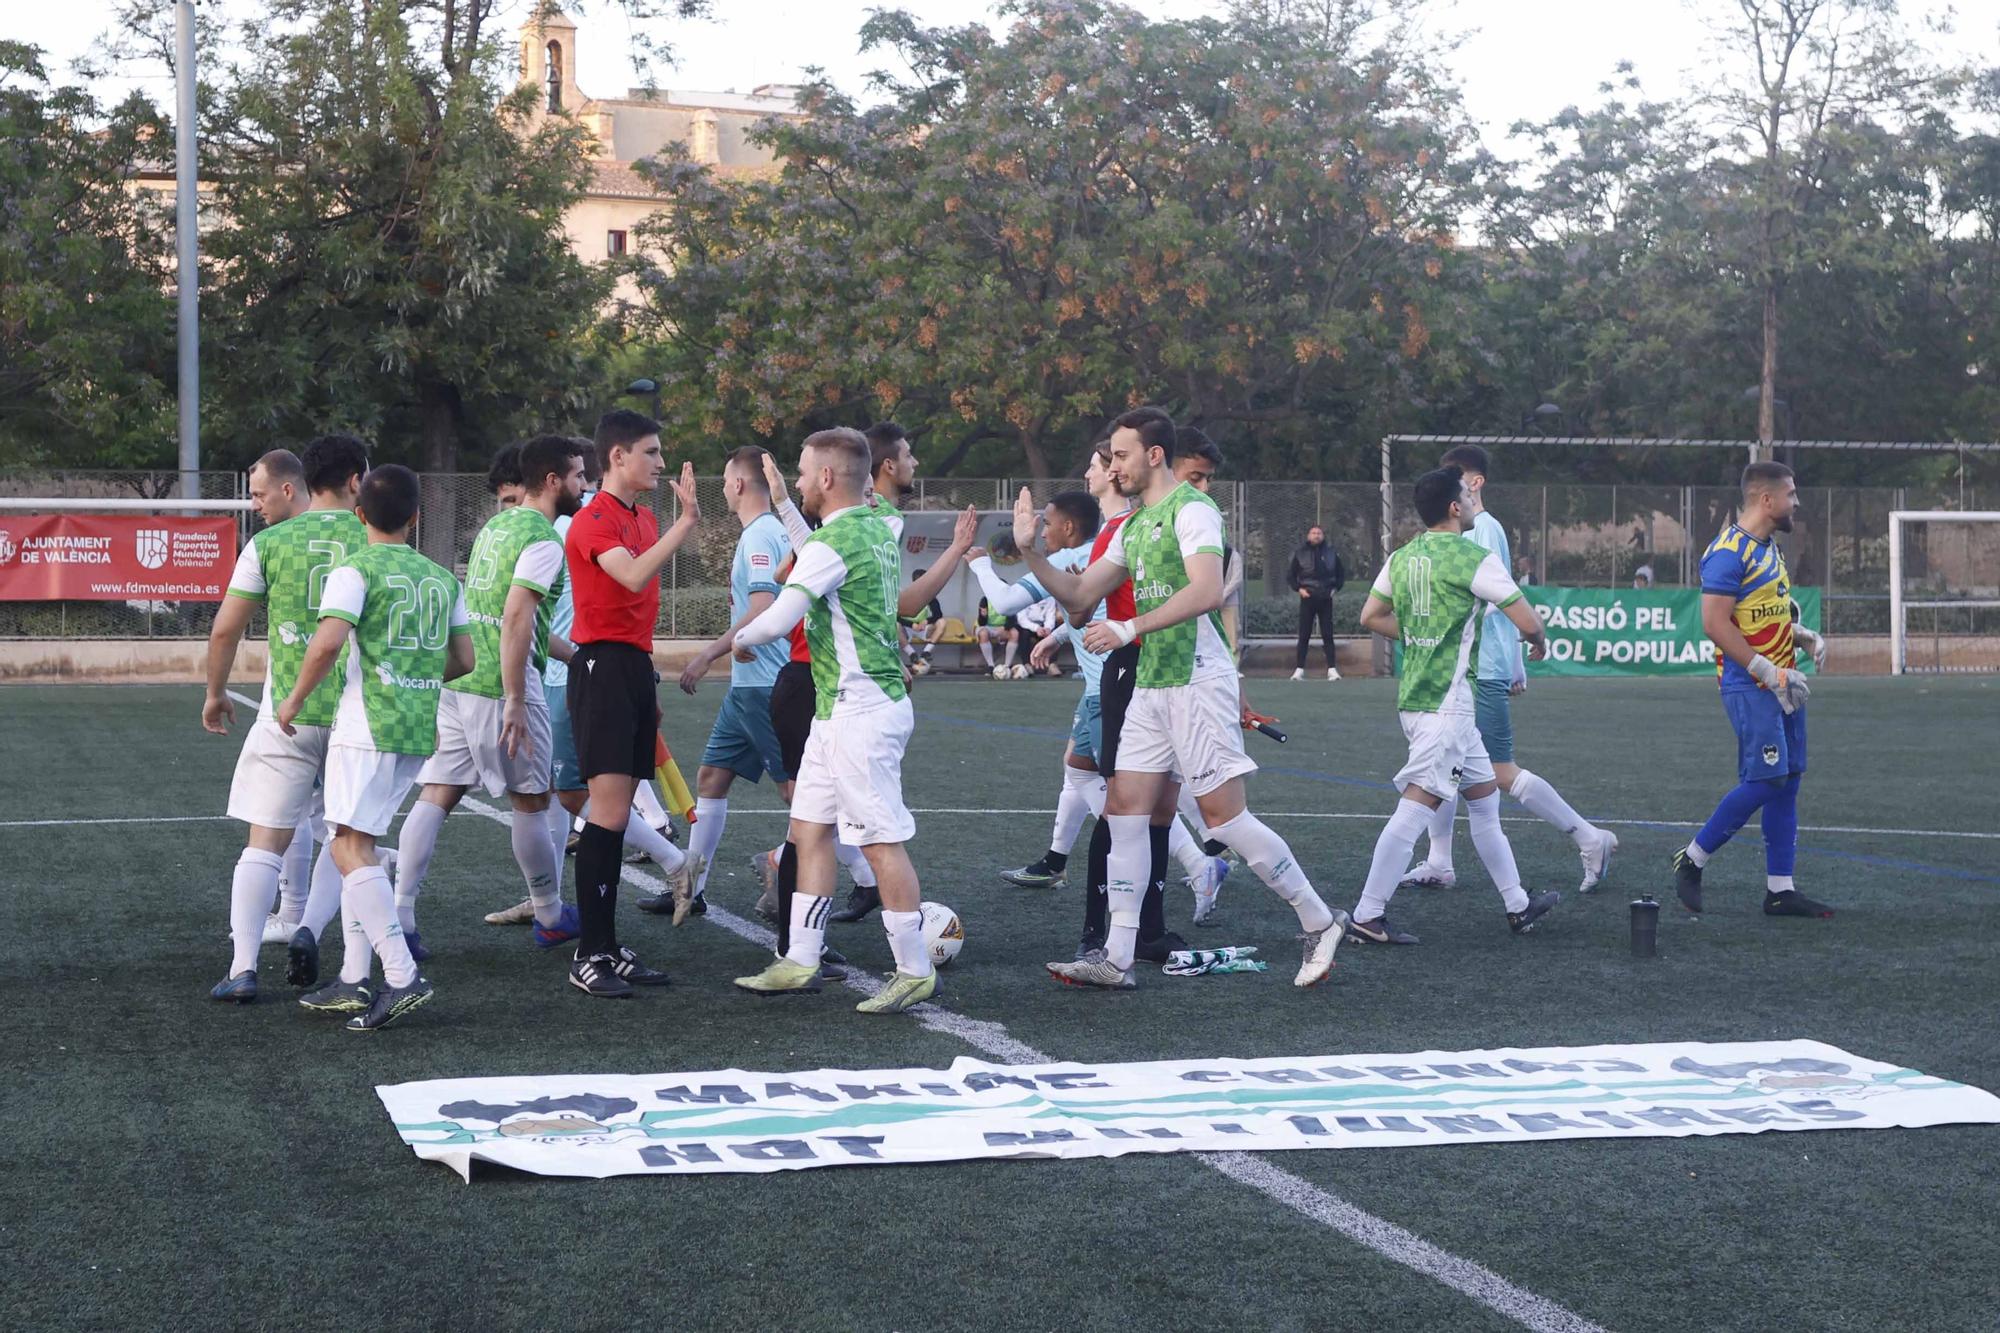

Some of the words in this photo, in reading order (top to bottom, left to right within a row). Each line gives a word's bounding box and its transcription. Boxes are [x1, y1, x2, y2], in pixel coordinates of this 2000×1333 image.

[22, 536, 112, 549] AJUNTAMENT
[173, 532, 218, 541] Fundació
[173, 541, 219, 551] Esportiva
[21, 552, 39, 564] DE
[45, 548, 112, 564] VALÈNCIA
[172, 558, 214, 567] València
[173, 550, 220, 560] Municipal
[467, 527, 509, 590] 15
[91, 581, 220, 594] www.fdmvalencia.es
[1408, 556, 1431, 616] 11
[386, 575, 450, 650] 20
[1534, 600, 1628, 630] PASSIÓ
[1635, 607, 1677, 630] PEL
[1595, 640, 1716, 663] POPULAR
[638, 1136, 885, 1168] NOT
